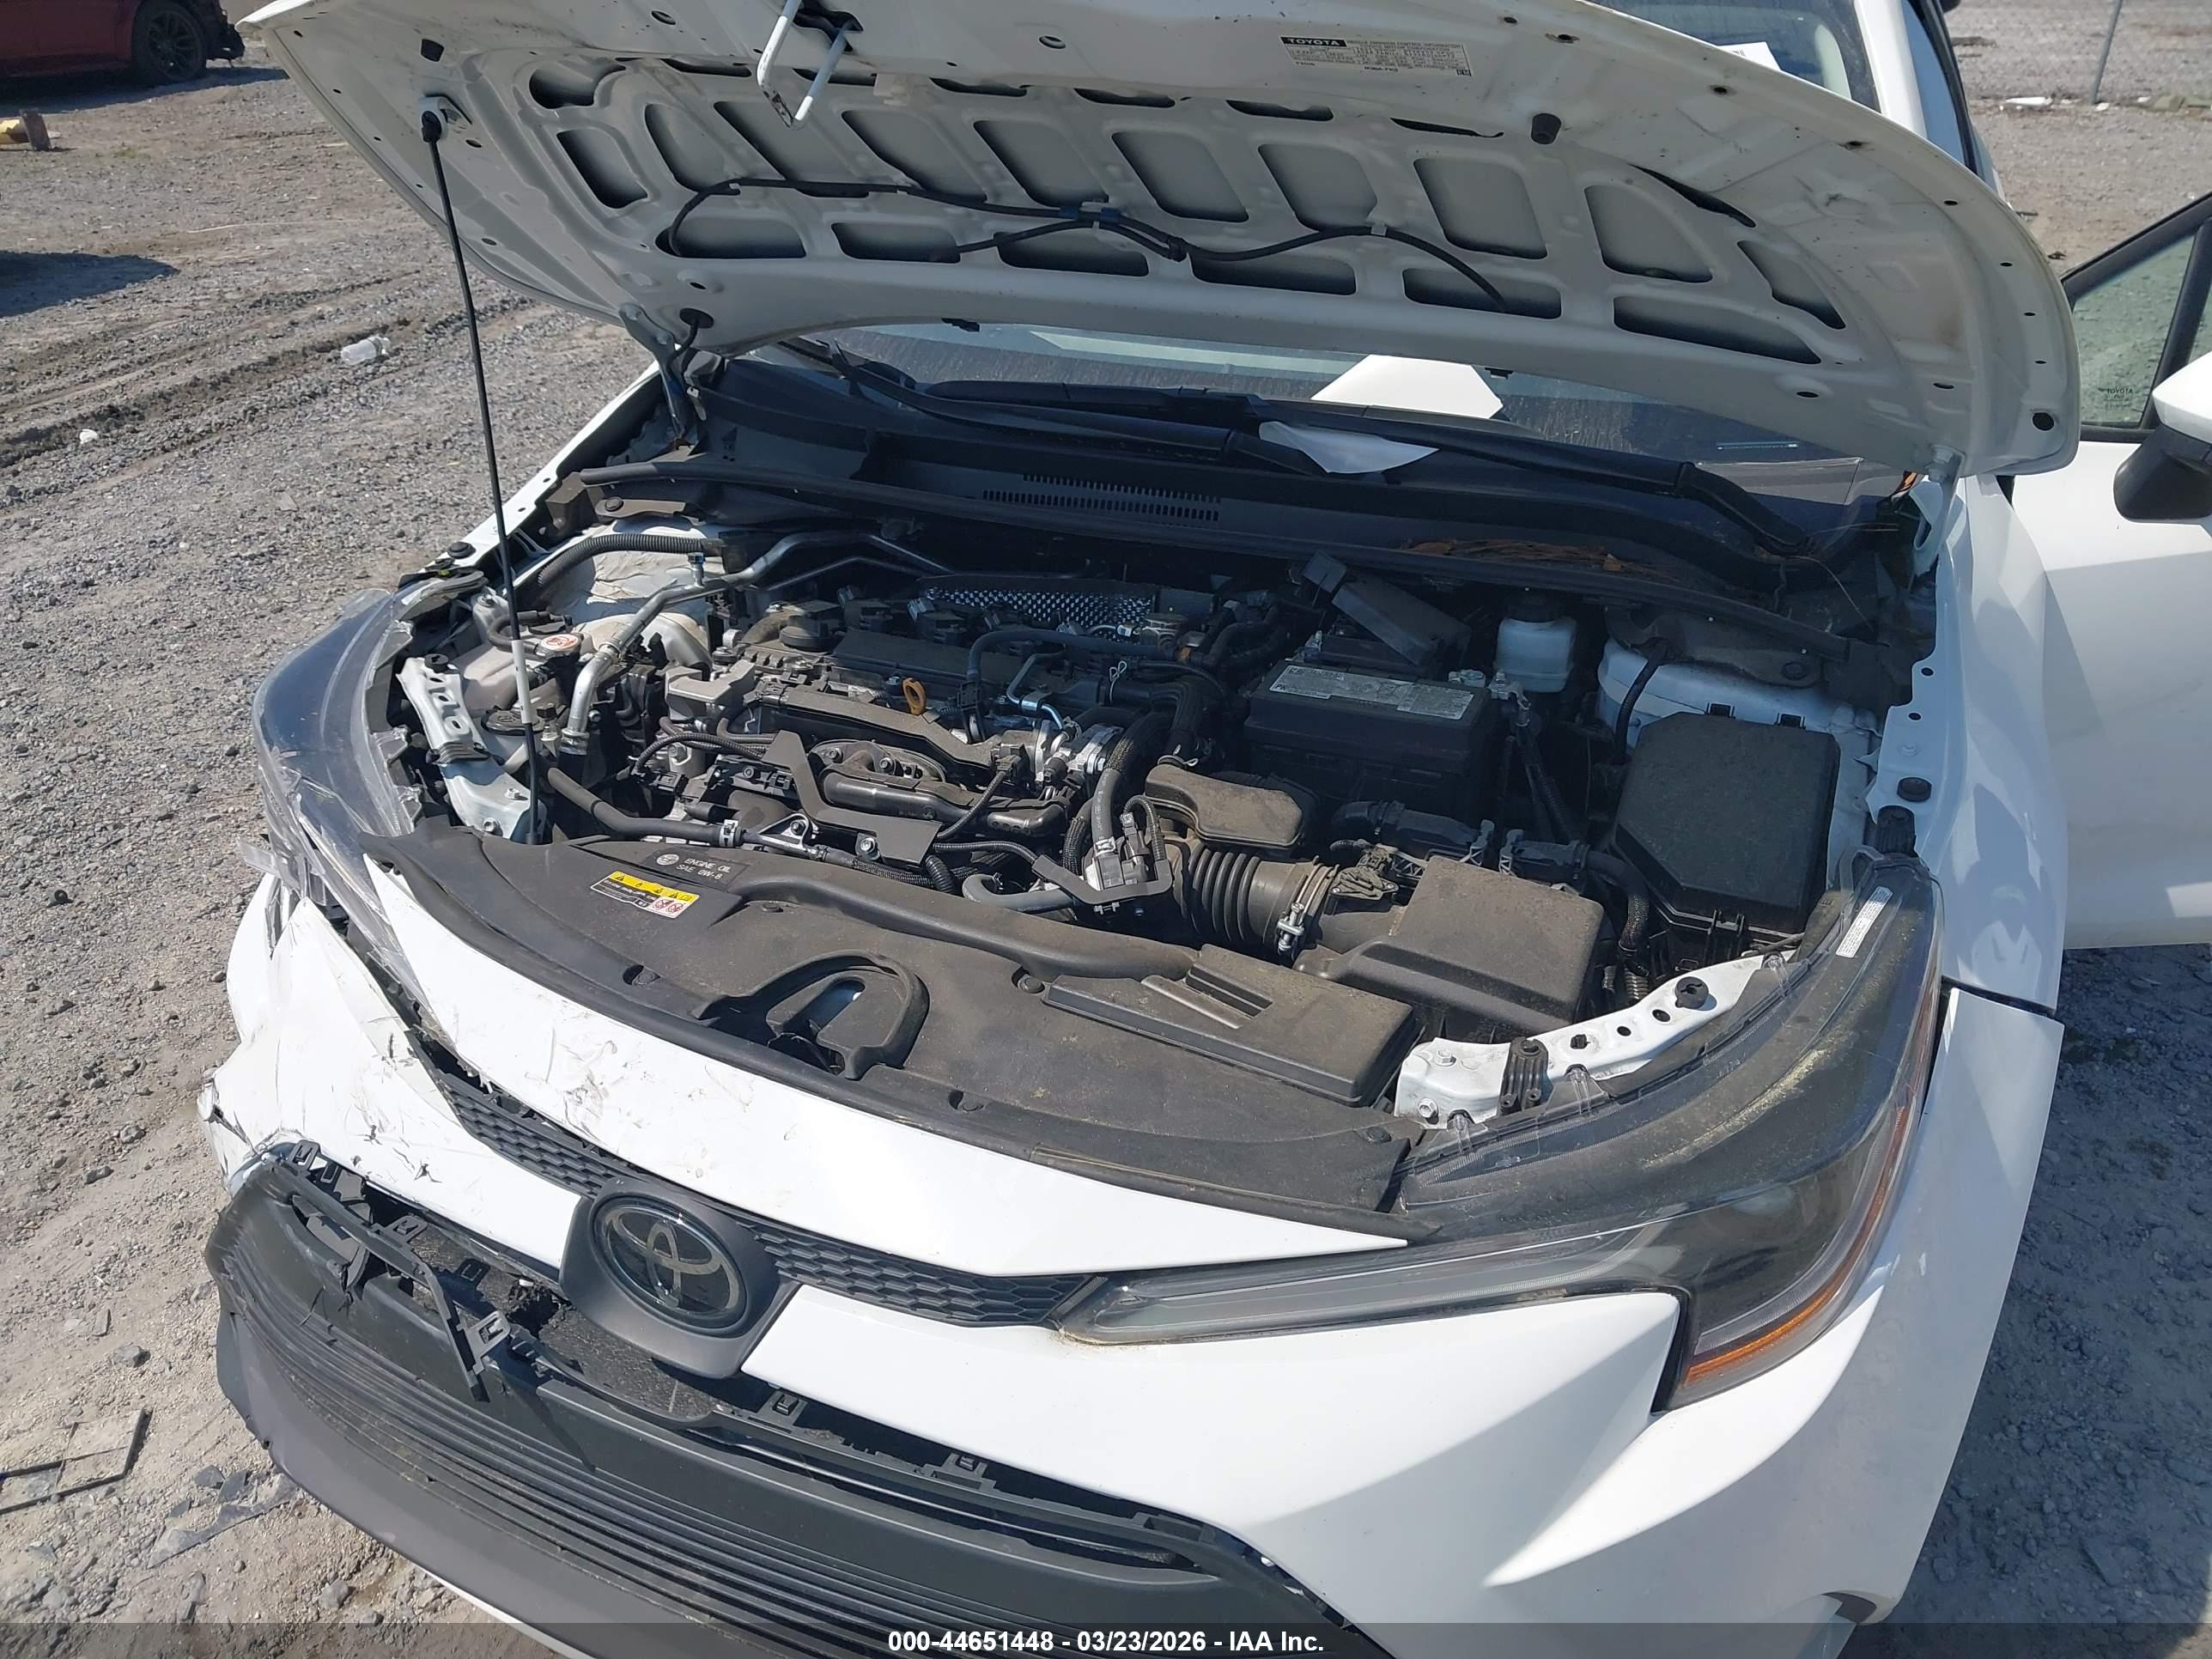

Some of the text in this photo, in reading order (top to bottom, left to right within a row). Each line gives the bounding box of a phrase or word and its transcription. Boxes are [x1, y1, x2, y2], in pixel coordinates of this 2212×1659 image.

[1289, 38, 1340, 46] TOYOTA
[677, 864, 723, 879] SAE 0W-8
[684, 858, 732, 873] ENGINE OIL
